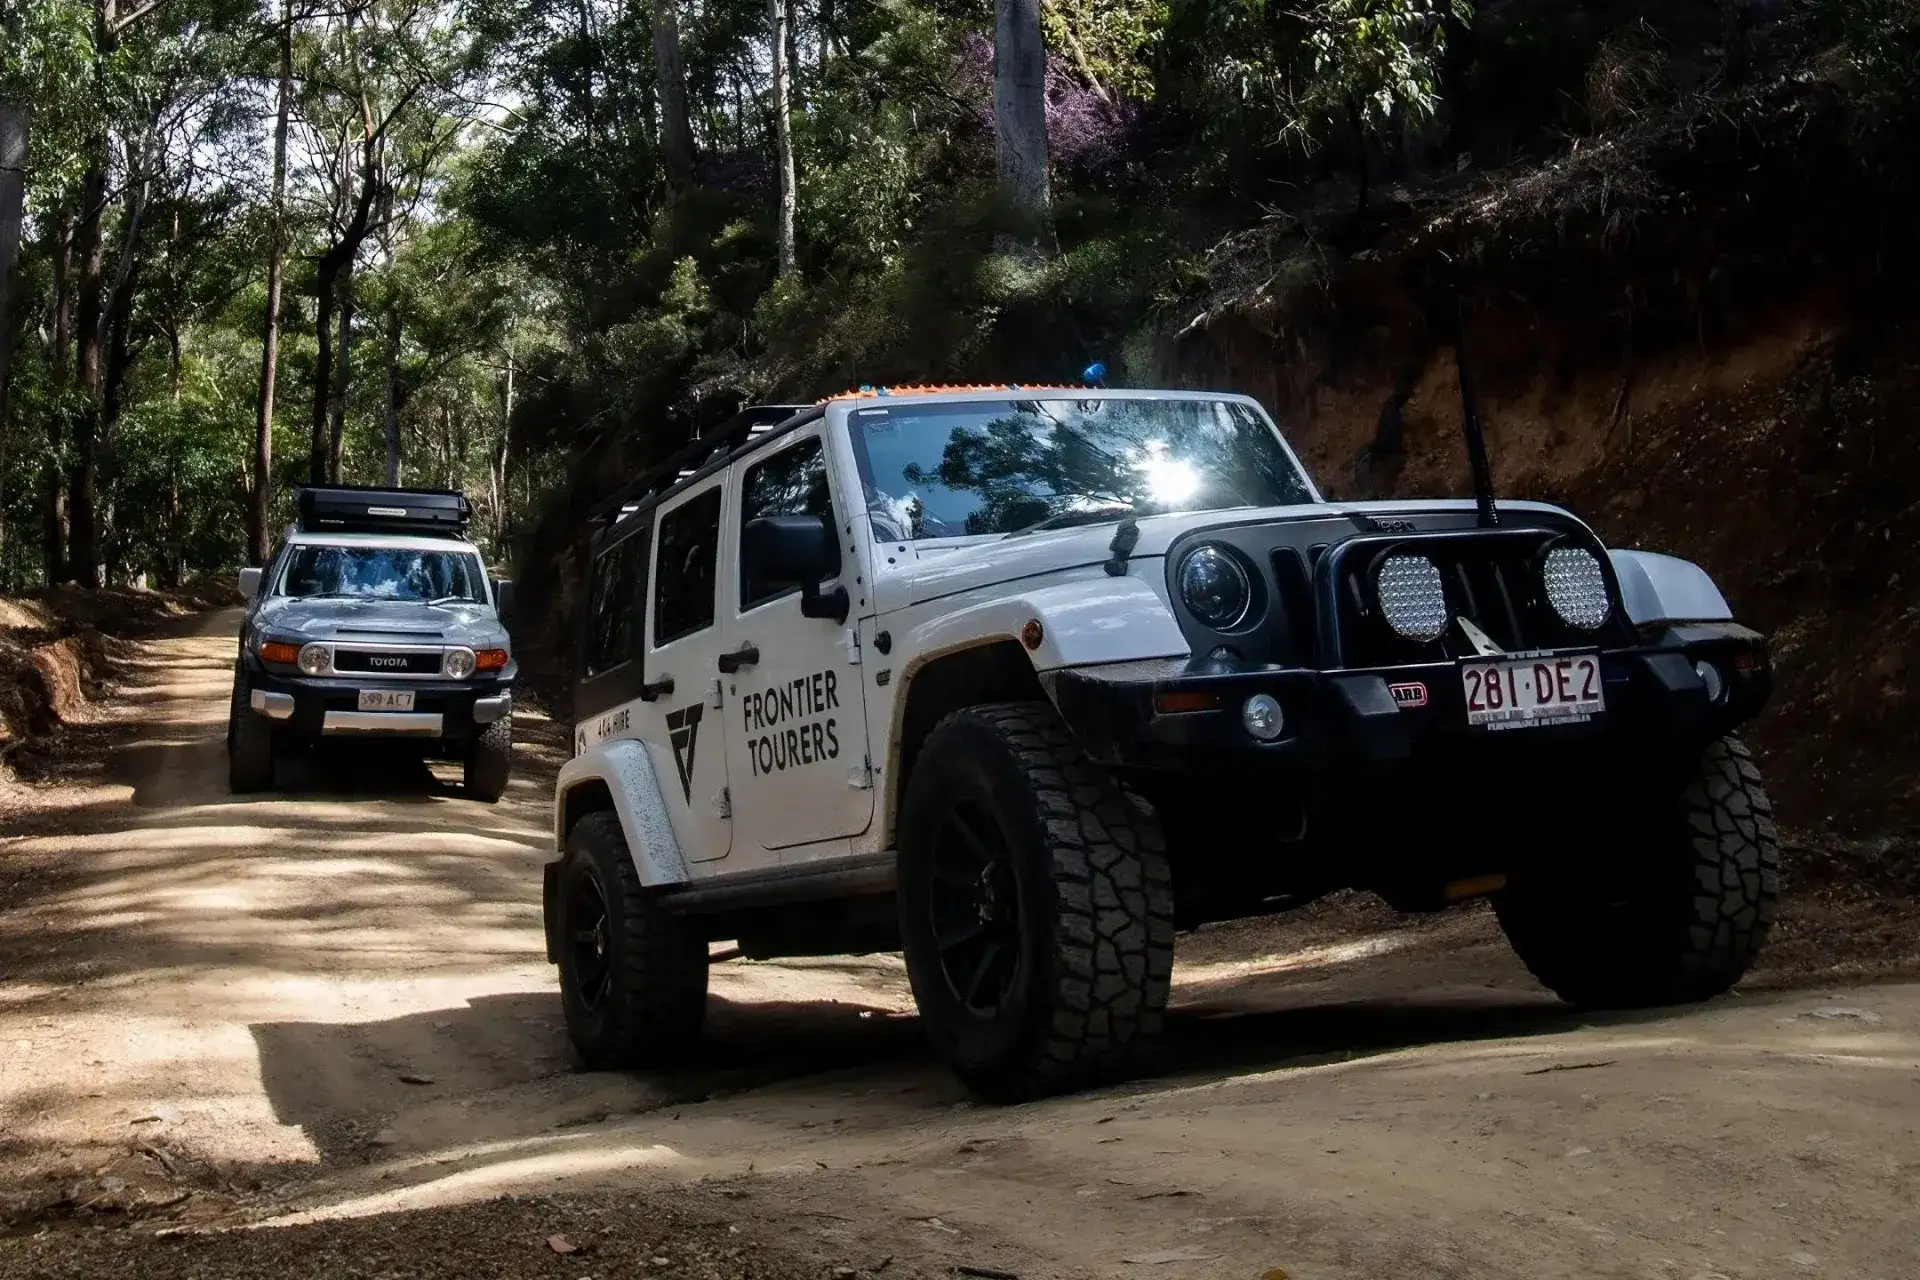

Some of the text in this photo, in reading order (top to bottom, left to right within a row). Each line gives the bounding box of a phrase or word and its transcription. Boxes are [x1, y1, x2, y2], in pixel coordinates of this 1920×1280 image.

[369, 657, 408, 668] TOYOTA
[743, 669, 840, 732] FRONTIER
[747, 718, 839, 776] TOURERS
